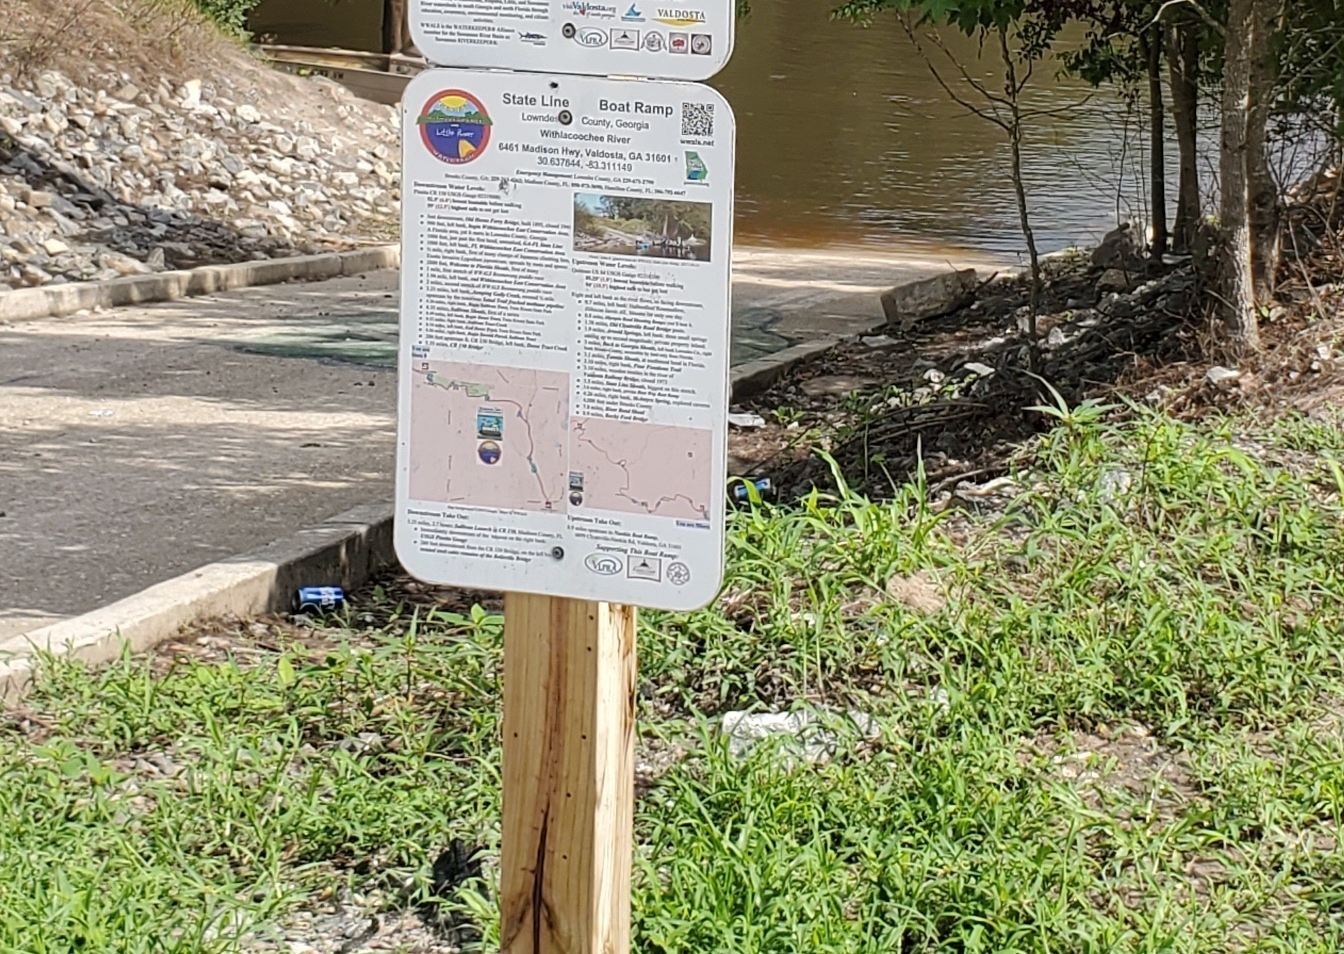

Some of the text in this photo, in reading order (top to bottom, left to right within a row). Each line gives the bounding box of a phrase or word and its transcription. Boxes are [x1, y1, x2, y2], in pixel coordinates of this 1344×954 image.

[658, 8, 706, 20] VALDOSTA
[502, 92, 674, 118] State Line Boat Ramp
[582, 116, 614, 129] County,
[616, 119, 650, 132] Georgia
[540, 129, 631, 144] Withlacoochee River
[522, 144, 559, 155] Madison
[562, 147, 583, 158] Hwy,
[585, 148, 627, 161] Valdosta,
[628, 151, 644, 162] GA
[596, 544, 628, 555] Supporting
[644, 549, 659, 557] Boat
